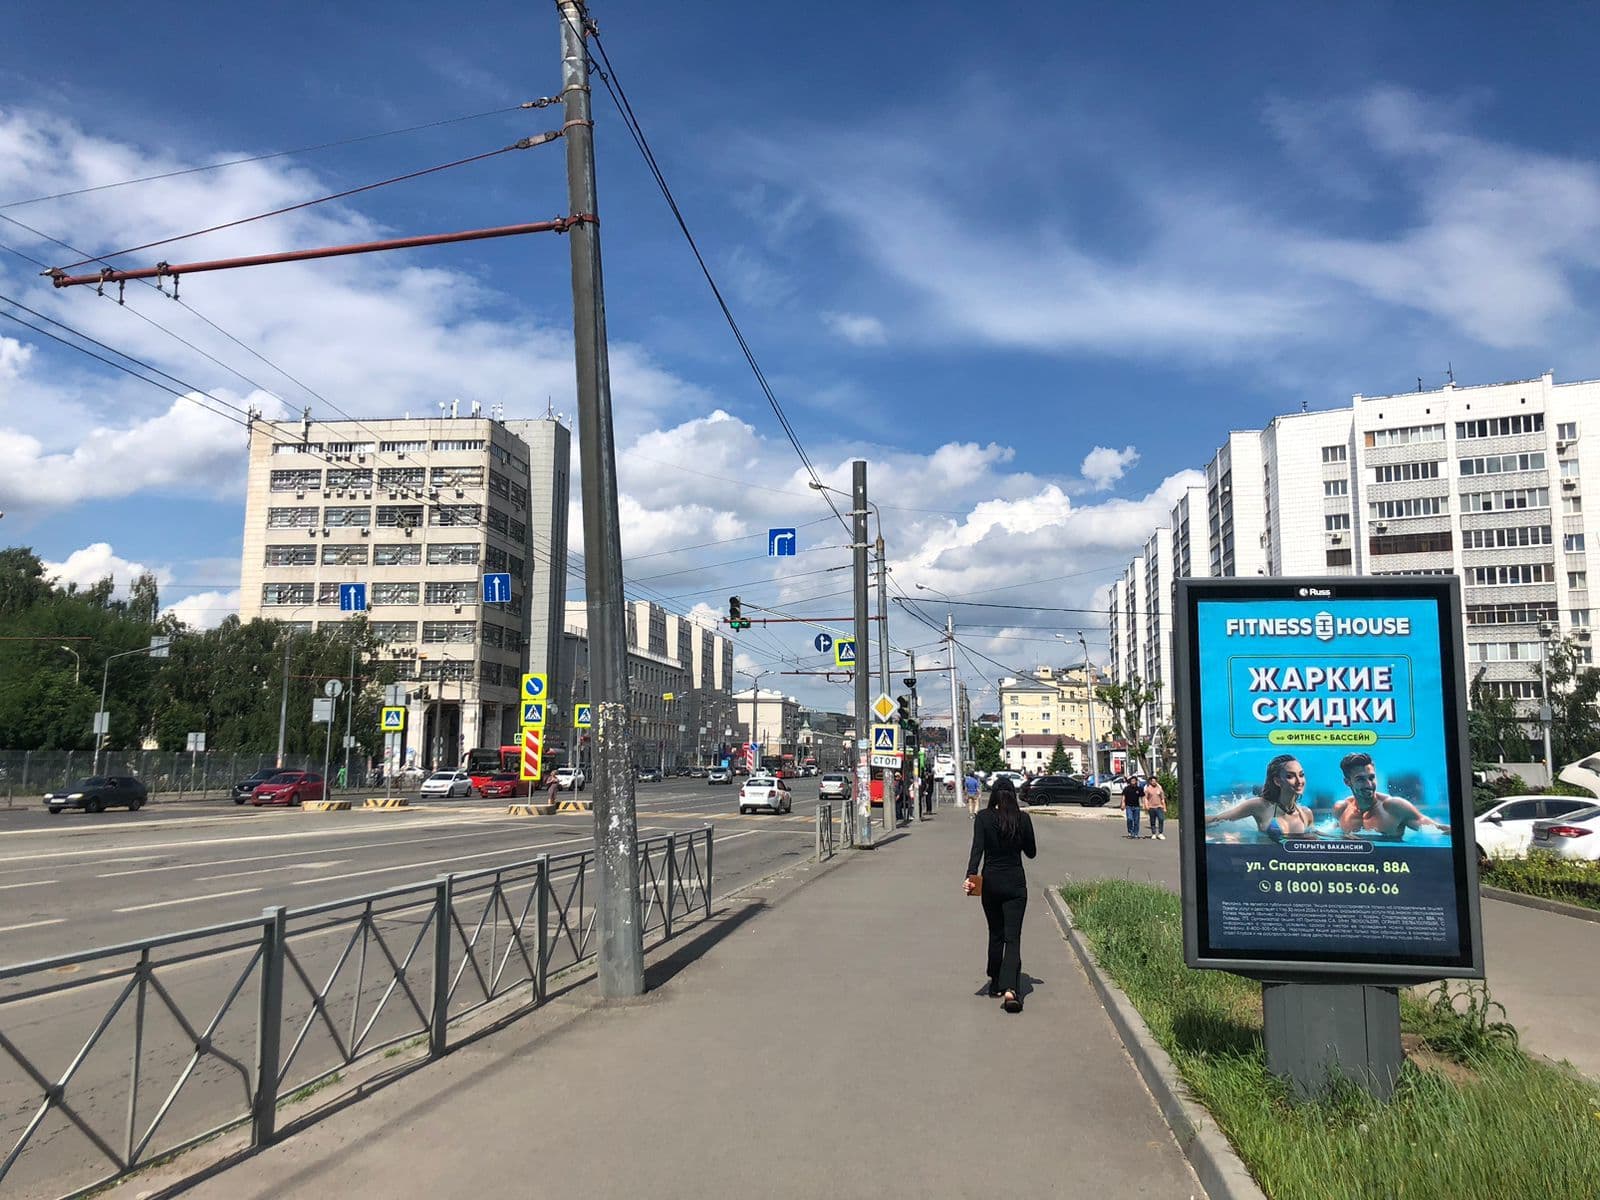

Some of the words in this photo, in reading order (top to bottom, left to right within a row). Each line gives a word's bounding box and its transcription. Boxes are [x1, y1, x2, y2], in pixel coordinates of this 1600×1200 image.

[1309, 588, 1331, 596] Russ
[1226, 619, 1312, 636] FITNESS
[1337, 617, 1411, 635] HOUSE
[1248, 666, 1393, 692] ЖАРКИЕ
[1252, 697, 1396, 727] СКИДКИ
[1287, 733, 1321, 741] ФИТНЕС
[1330, 732, 1370, 741] БАССЕЙН
[873, 756, 898, 766] СТОП
[1246, 861, 1265, 873] ул.
[1269, 859, 1379, 874] Спартаковская,
[1383, 861, 1411, 873] 88А
[1274, 881, 1283, 892] 8
[1287, 880, 1323, 894] (800)
